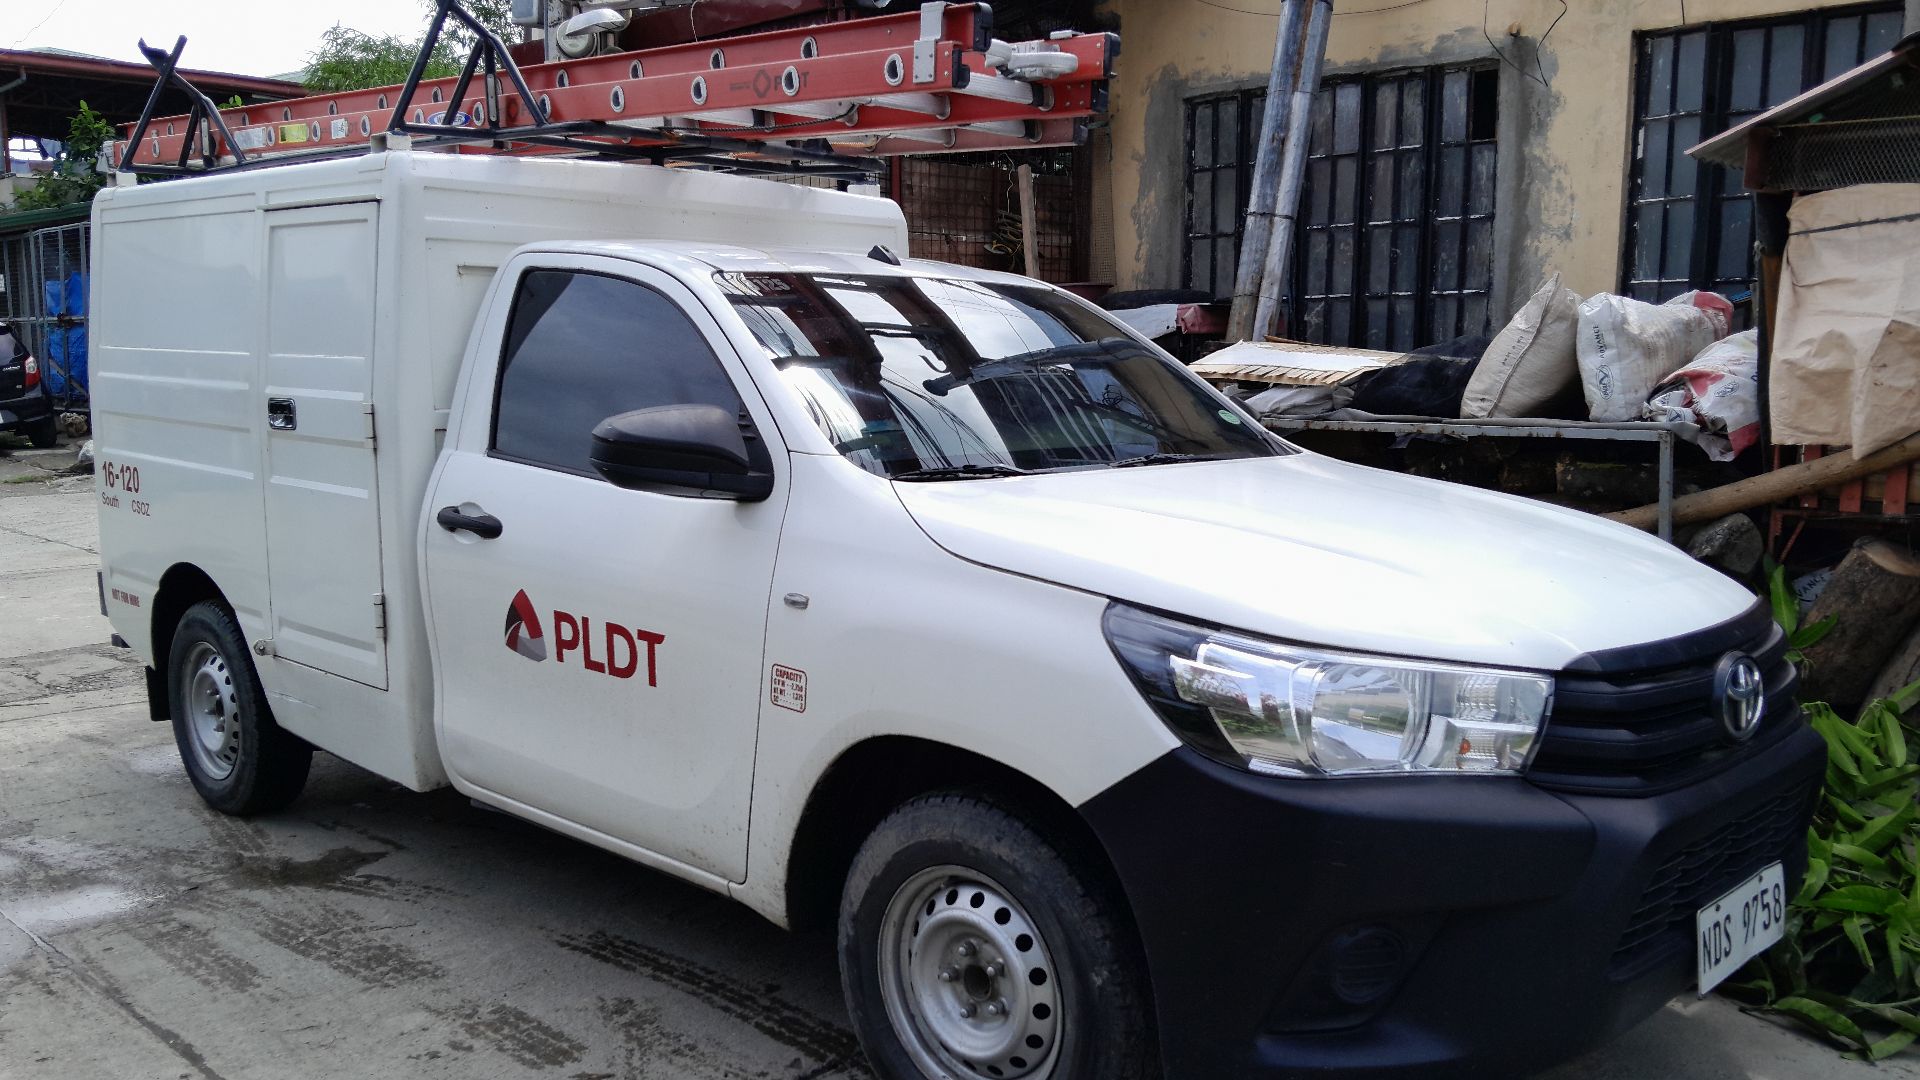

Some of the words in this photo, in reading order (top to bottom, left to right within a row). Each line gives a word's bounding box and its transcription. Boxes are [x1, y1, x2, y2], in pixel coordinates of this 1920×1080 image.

[102, 460, 139, 493] 16-120
[102, 492, 120, 508] South
[553, 610, 666, 688] PLDT
[775, 668, 802, 683] CAPACITY
[1701, 913, 1733, 975] NDS
[1742, 882, 1783, 945] 9758
